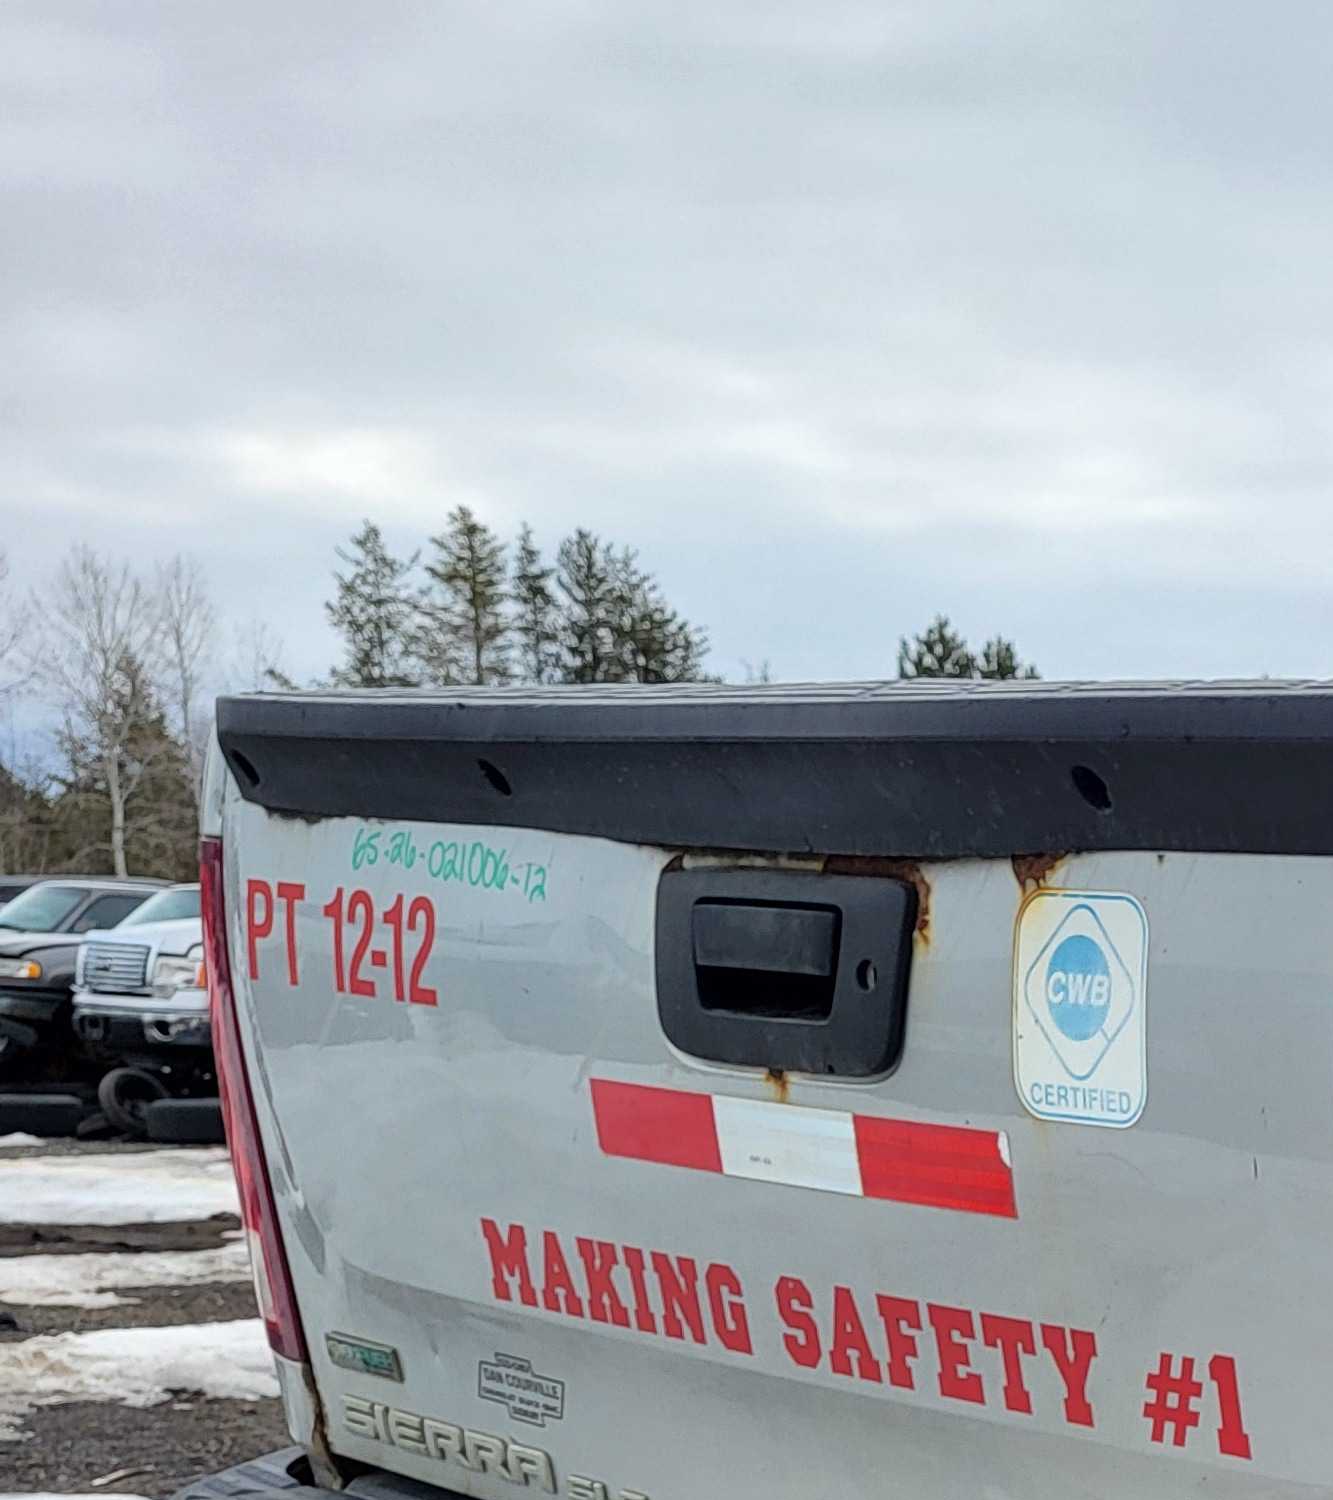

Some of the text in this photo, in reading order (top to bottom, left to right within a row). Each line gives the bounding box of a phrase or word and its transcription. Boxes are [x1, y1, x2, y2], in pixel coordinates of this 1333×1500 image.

[247, 880, 438, 1008] PT 12-12
[1048, 970, 1110, 1007] CWB
[1030, 1082, 1132, 1115] CERTIFIED
[480, 1217, 1253, 1461] MAKING SAFETY #1
[341, 1393, 558, 1494] SIERRA
